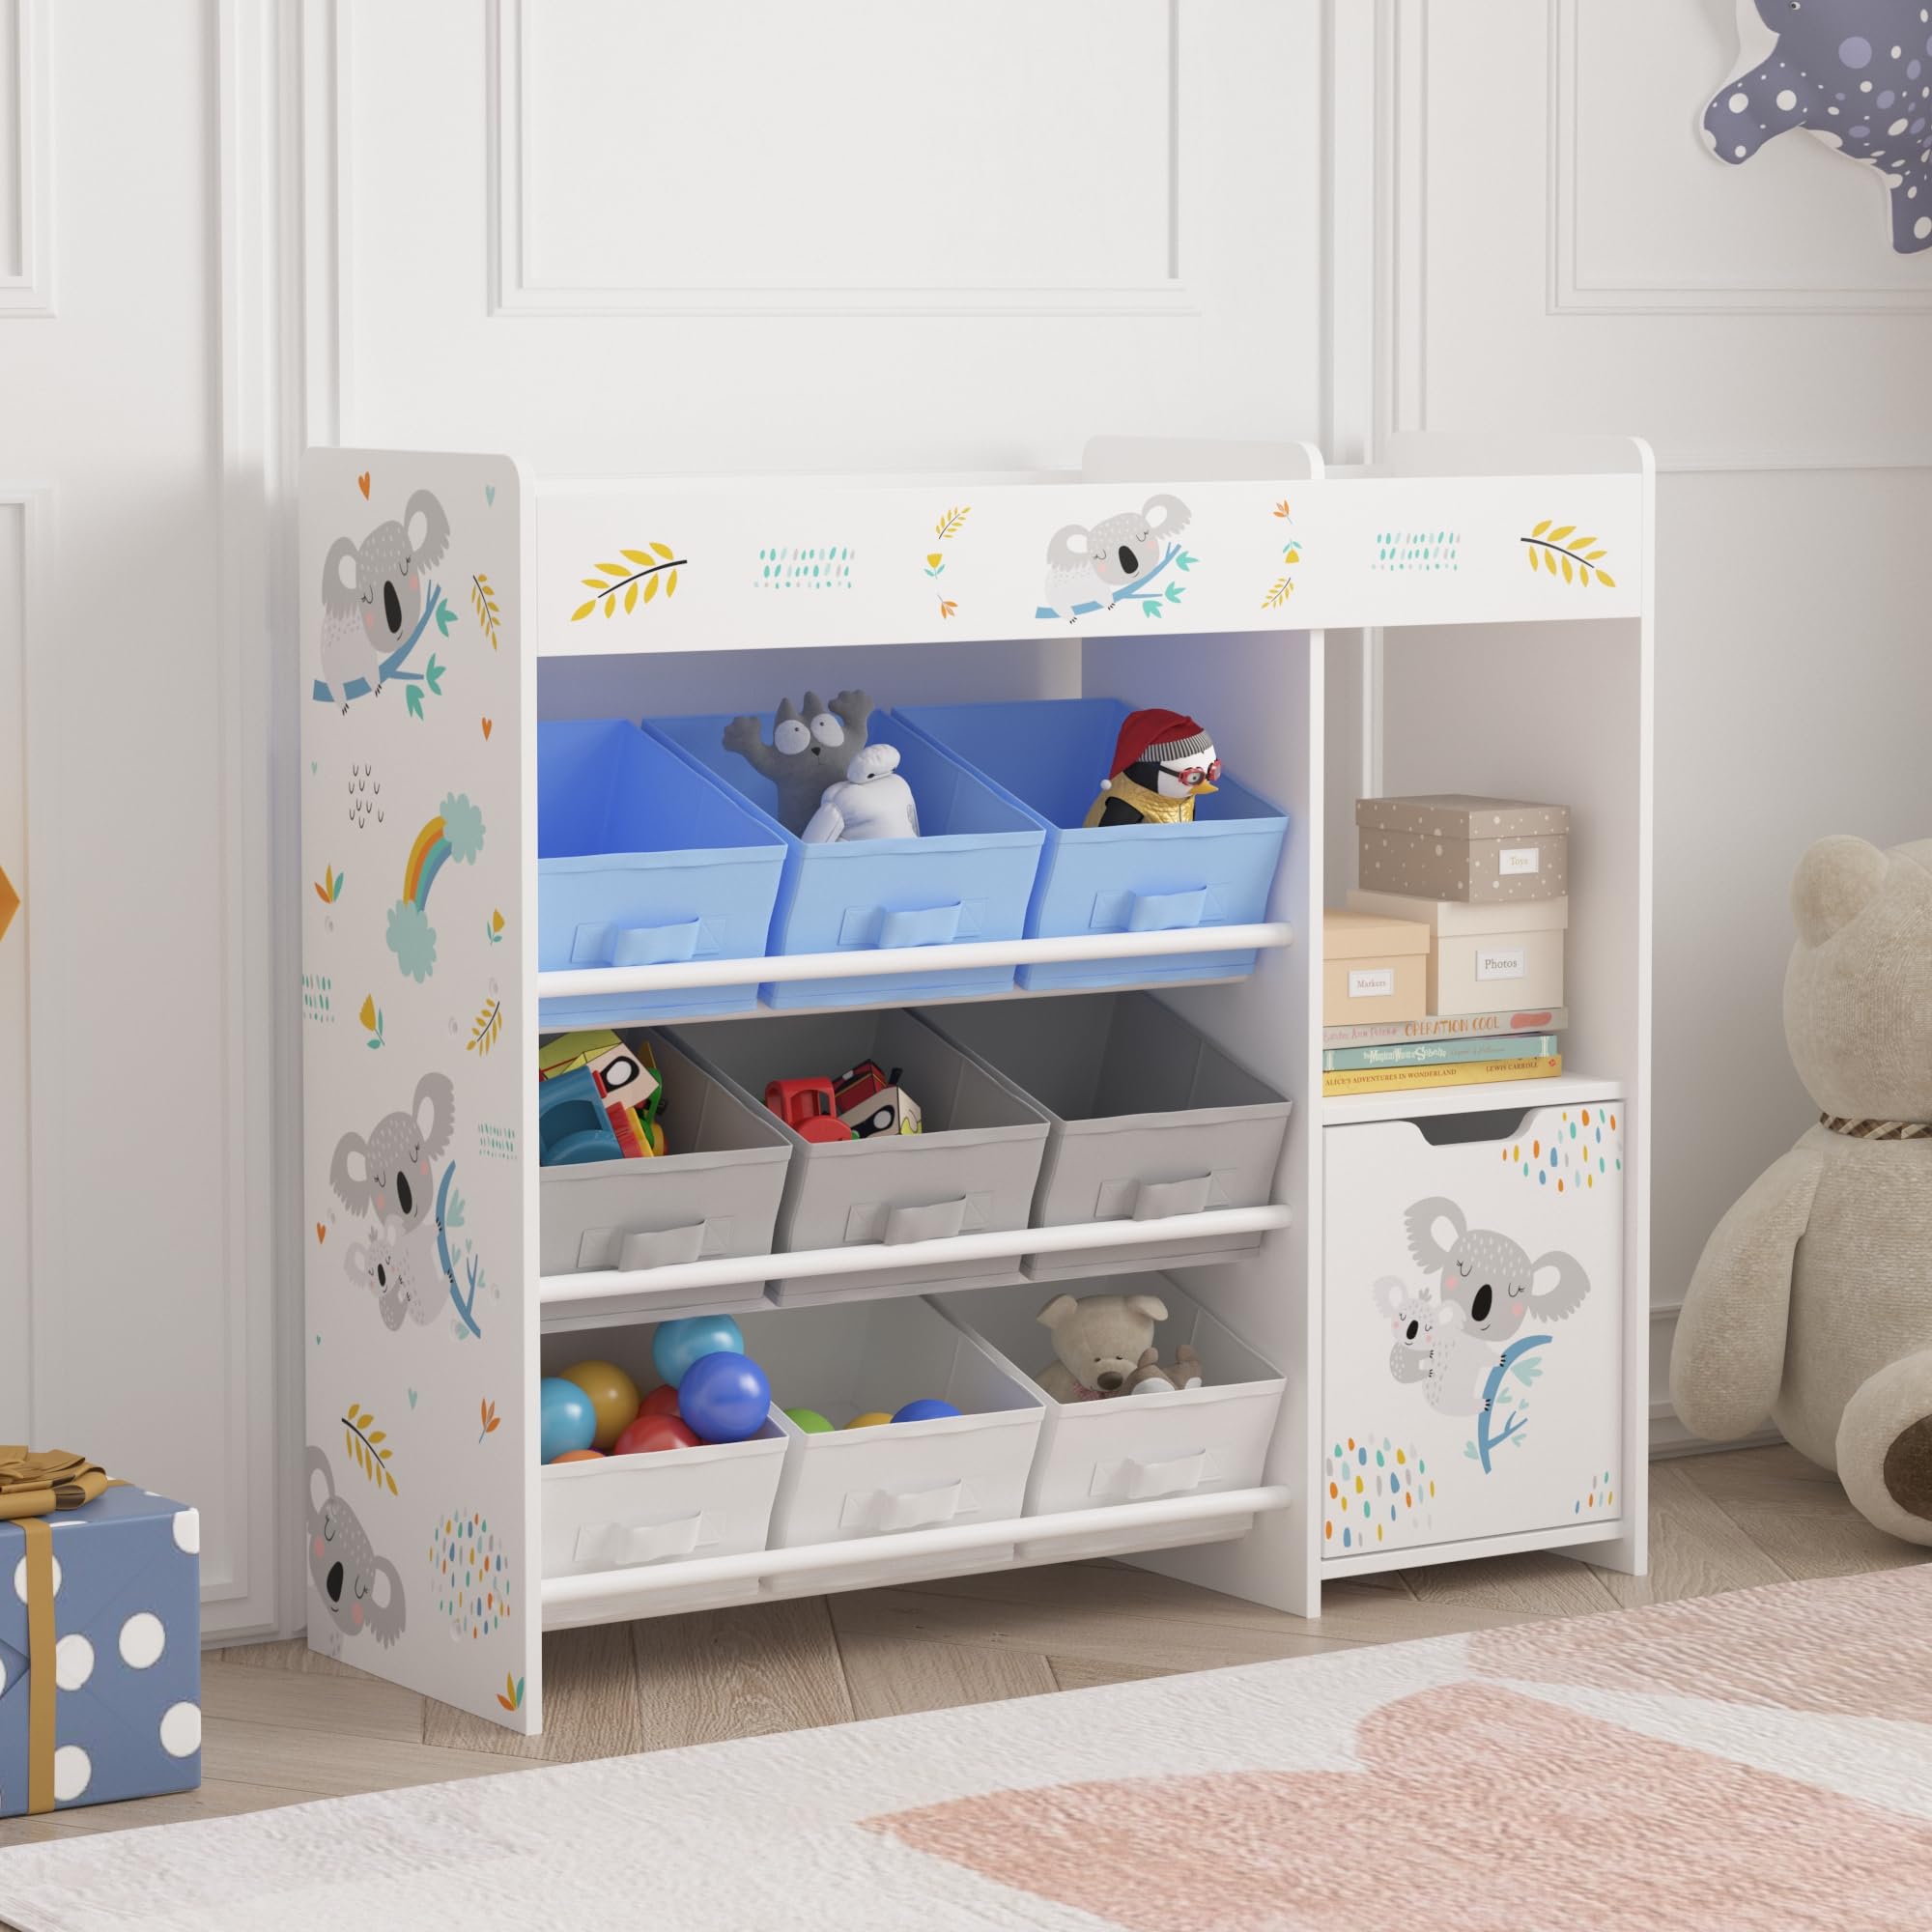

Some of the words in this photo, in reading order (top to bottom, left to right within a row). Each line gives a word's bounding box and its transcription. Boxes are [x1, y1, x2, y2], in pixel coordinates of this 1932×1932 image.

[1510, 856, 1529, 867] Toys
[1485, 958, 1518, 970] Photos
[1356, 979, 1386, 989] Markers
[1405, 1019, 1468, 1037] OPERATION
[1472, 1016, 1500, 1031] COOL
[1507, 1062, 1539, 1071] CARROLL
[1325, 1077, 1351, 1087] ALICE'S
[1352, 1073, 1398, 1083] ADVENTURES
[1407, 1068, 1457, 1079] WONDERLAND
